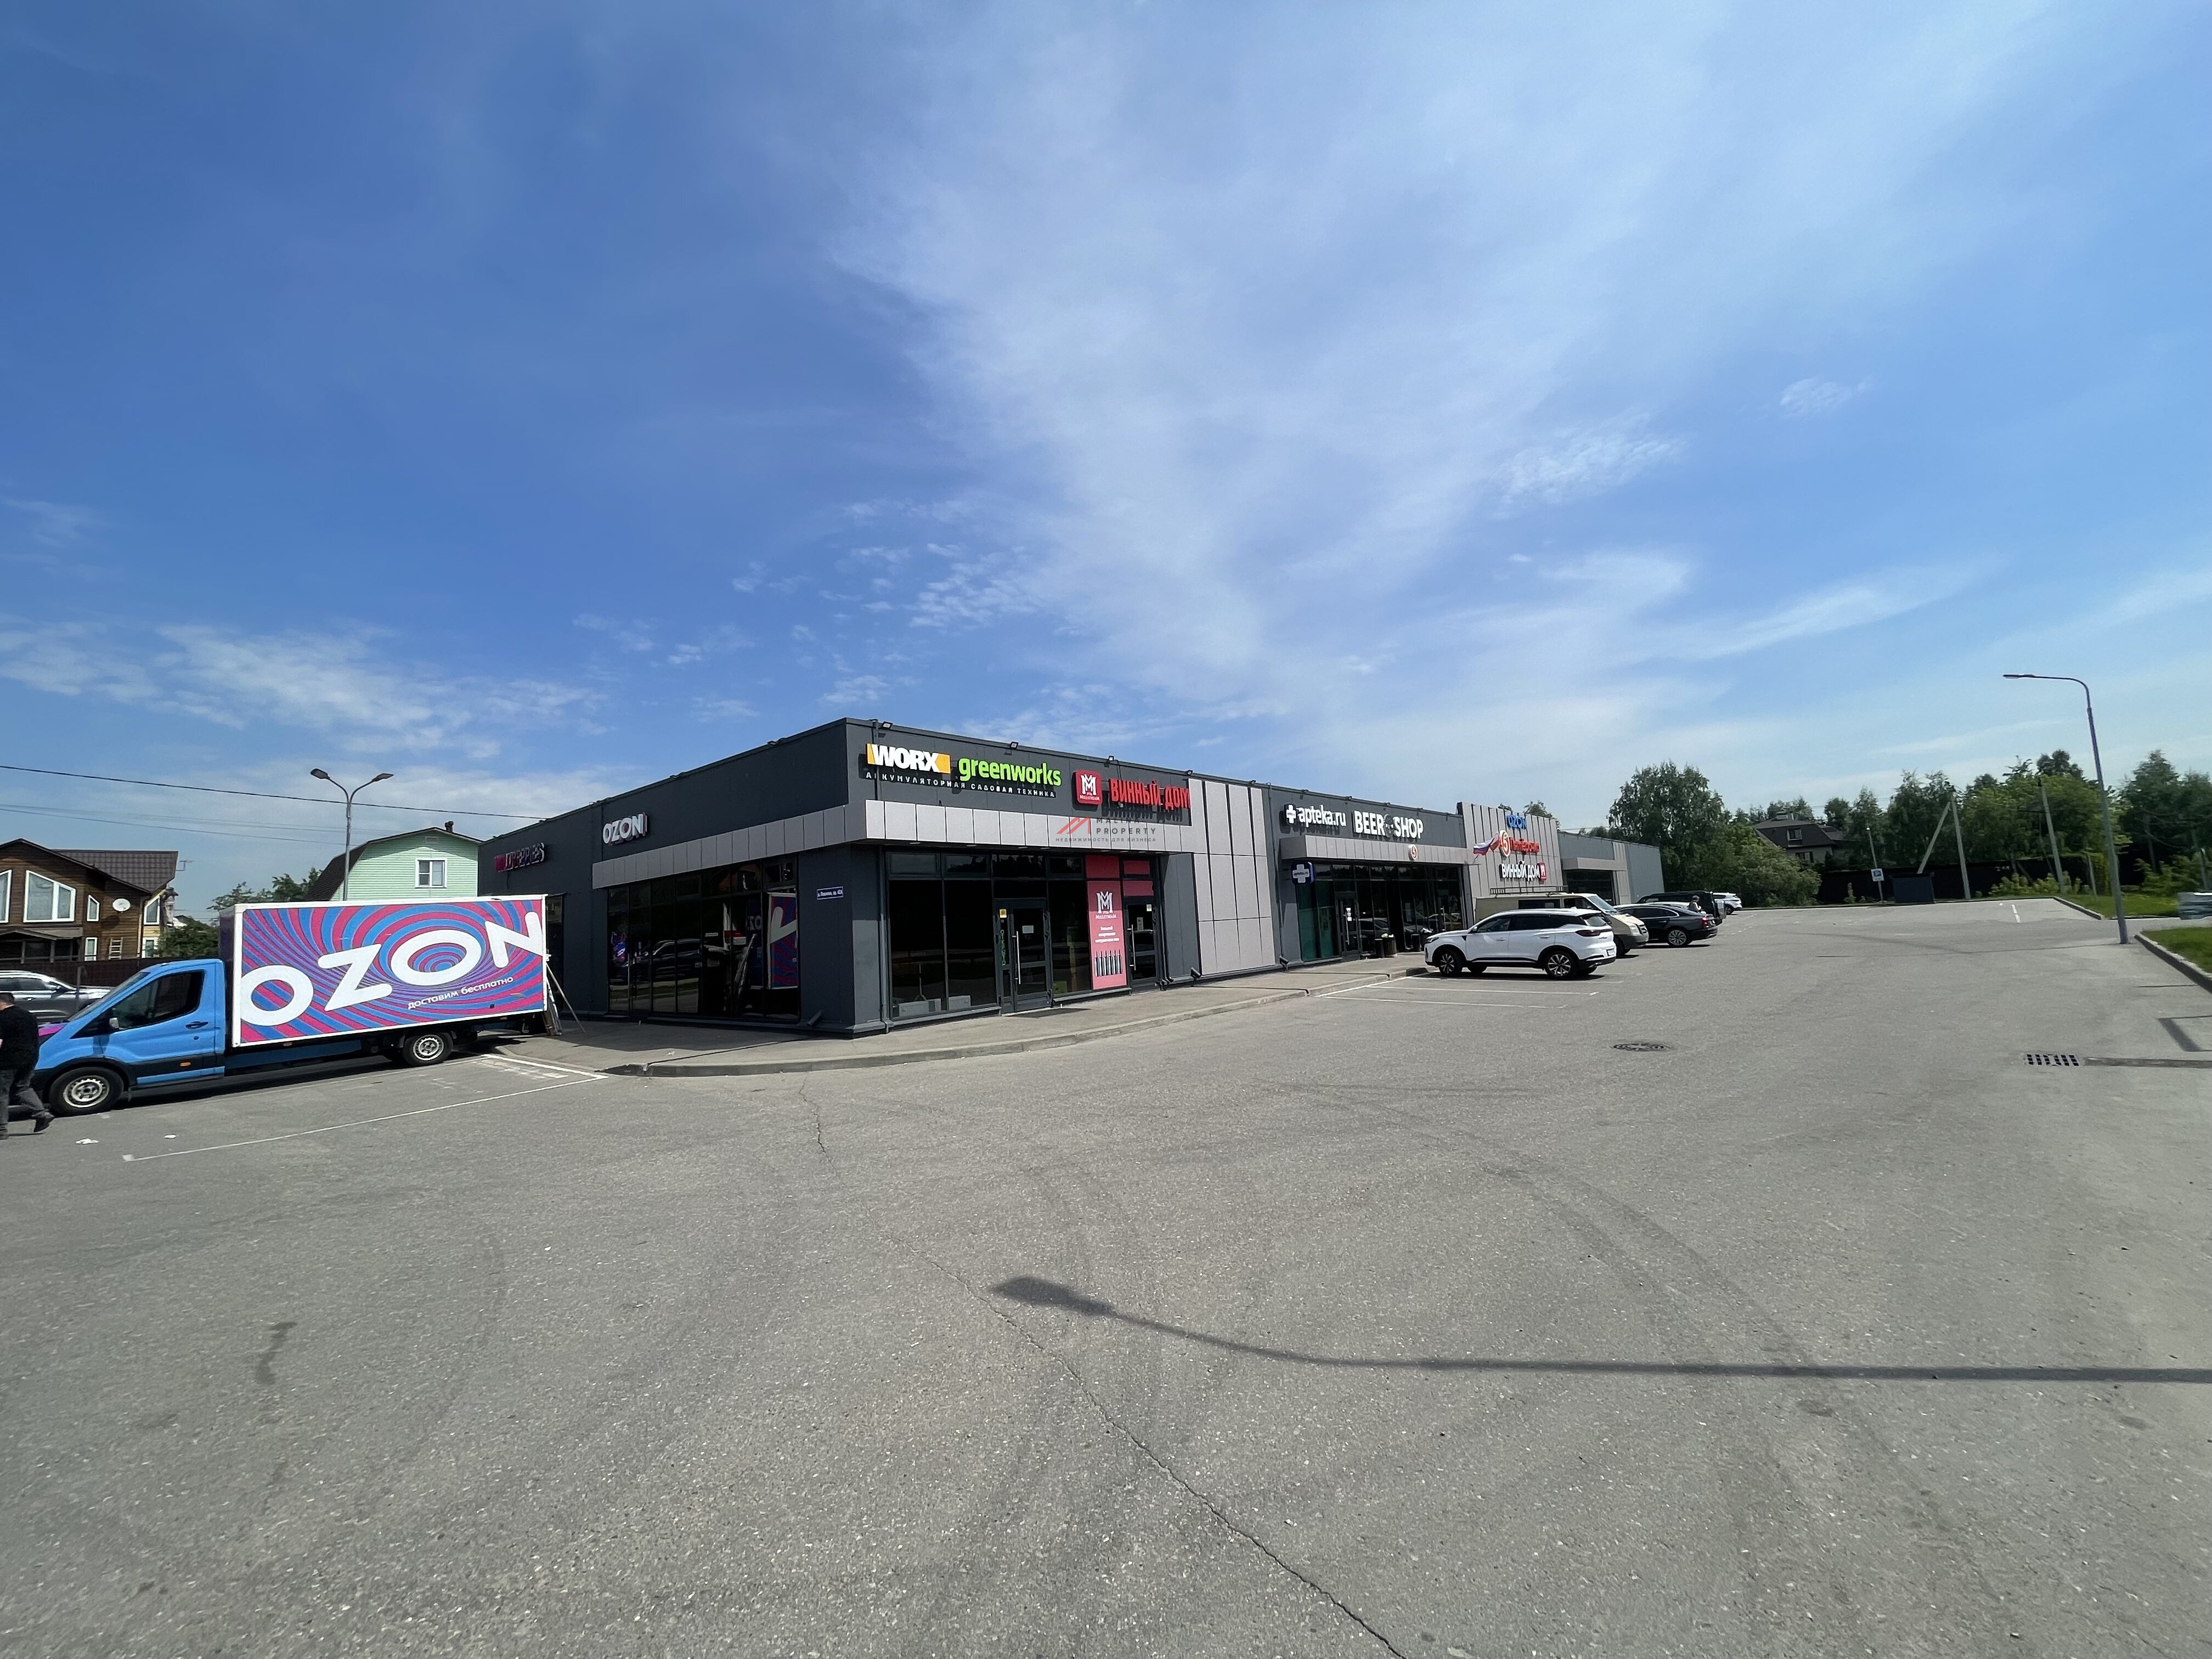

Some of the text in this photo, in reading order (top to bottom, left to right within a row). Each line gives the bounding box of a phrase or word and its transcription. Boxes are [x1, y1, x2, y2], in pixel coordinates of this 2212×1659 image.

[871, 744, 940, 773] WORX
[958, 758, 1062, 787] greenworks
[866, 771, 1055, 798] АКУМУЛЯТОРНАЯ САДОВАЯ ТЕХНИКА
[1109, 778, 1191, 811] ВИННЫЙ ДОМ
[603, 814, 644, 844] OZON
[1296, 804, 1347, 828] apteka.ru
[1353, 810, 1424, 839] BEER SHOP
[1508, 814, 1527, 829] OZON
[1502, 860, 1541, 882] ВИННЫЙ ДОМ
[240, 911, 543, 1026] OZON
[408, 976, 514, 1010] доставим бесплатно
